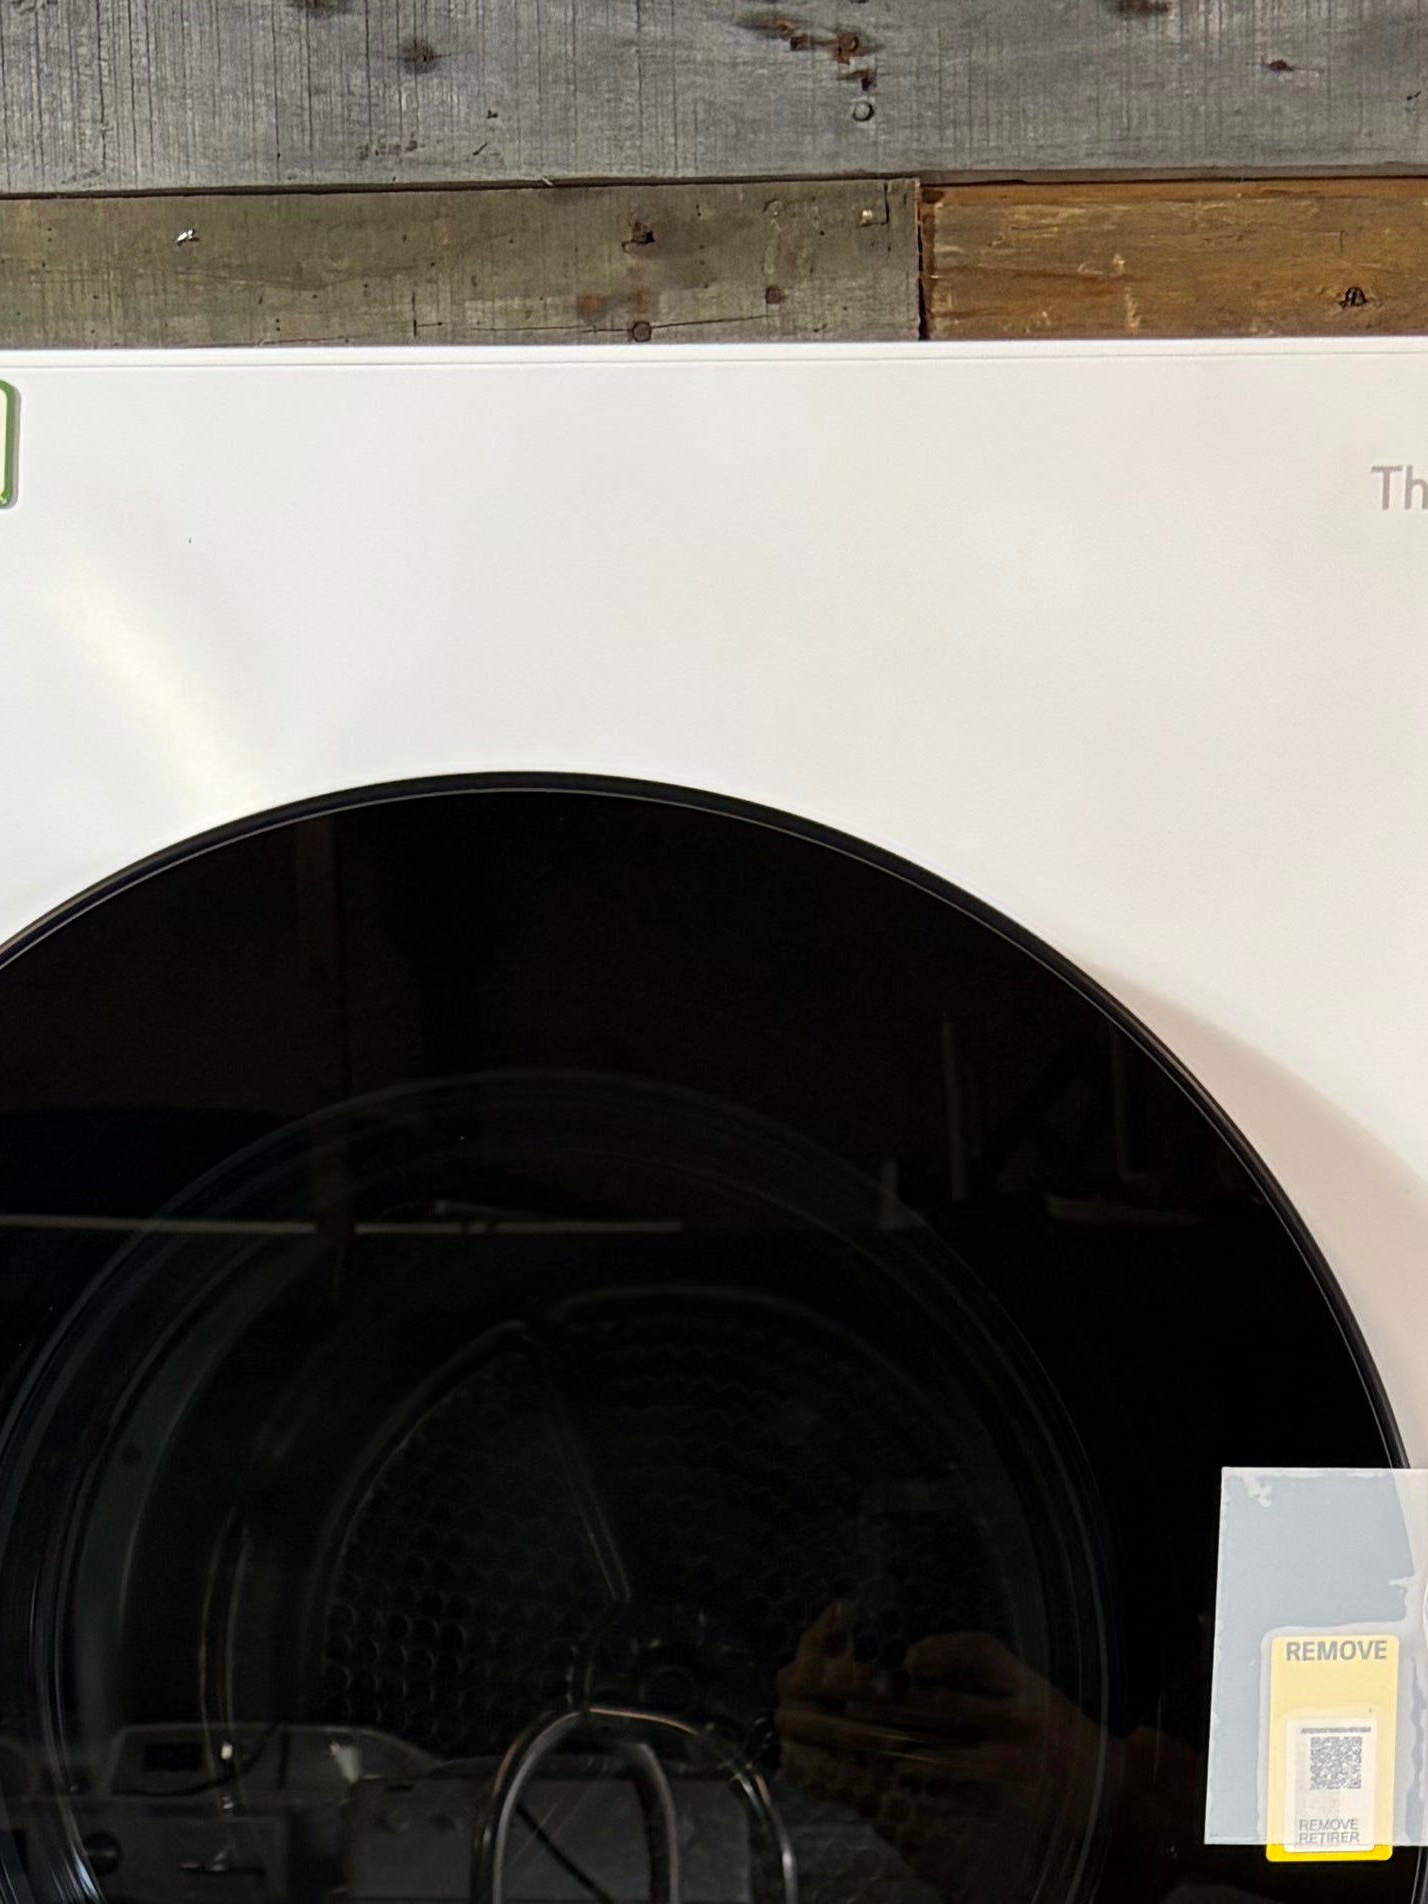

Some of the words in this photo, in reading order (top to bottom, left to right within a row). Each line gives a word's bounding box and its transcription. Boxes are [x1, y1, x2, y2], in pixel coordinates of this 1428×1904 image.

[1286, 1640, 1387, 1661] REMOVE
[1299, 1818, 1359, 1831] REMOVE
[1299, 1832, 1360, 1844] RETIRER
